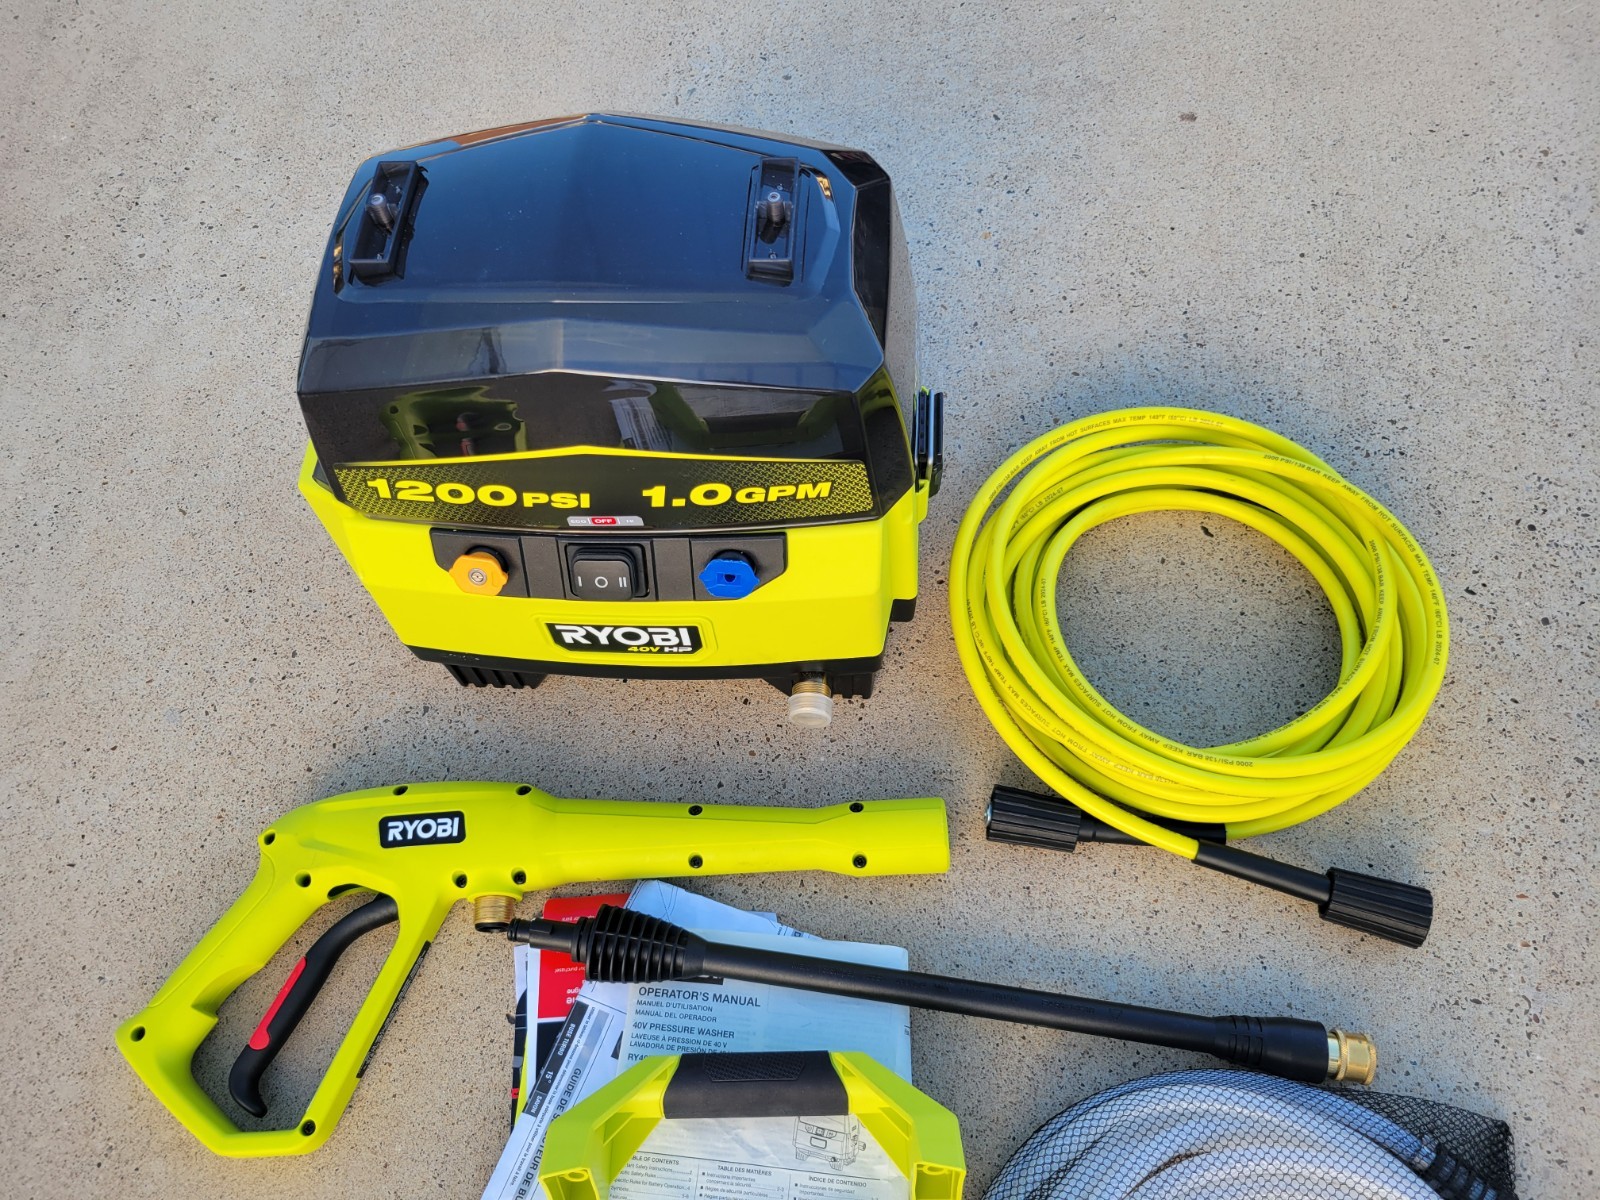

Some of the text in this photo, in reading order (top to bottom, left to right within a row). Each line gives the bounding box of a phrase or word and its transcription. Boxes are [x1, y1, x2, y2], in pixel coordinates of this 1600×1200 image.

[1020, 454, 1033, 466] KEEP
[1034, 444, 1048, 456] AWAY
[1050, 436, 1065, 446] FROM
[1066, 430, 1078, 438] HOT
[1080, 420, 1110, 432] SURFACES
[1306, 466, 1321, 474] BAR
[1323, 474, 1341, 483] KEEP
[366, 478, 590, 508] 1200 PSI
[642, 482, 832, 508] 1.0 GPM
[1044, 487, 1064, 502] 2024-07
[1342, 484, 1360, 497] AWAY
[1360, 496, 1379, 511] FROM
[1378, 510, 1392, 522] HOT
[1391, 523, 1416, 553] SURFACES
[1414, 553, 1426, 567] MAX
[1422, 570, 1434, 586] TEMP
[1041, 600, 1047, 608] LB
[1429, 589, 1440, 606] 140°F
[971, 621, 976, 629] LB
[554, 625, 692, 646] RYOBI
[1436, 630, 1442, 638] LB
[1053, 646, 1064, 662] TEMP
[1433, 641, 1442, 665] 2024-07
[994, 668, 1007, 684] TEMP
[1064, 664, 1074, 677] MAX
[1008, 685, 1020, 699] MAX
[1073, 678, 1101, 708] SURFACES
[1020, 699, 1050, 727] SURFACES
[1102, 708, 1116, 720] HOT
[1051, 727, 1066, 738] HOT
[1117, 718, 1137, 734] FROM
[1067, 737, 1088, 752] FROM
[1140, 732, 1160, 744] AWAY
[1163, 743, 1183, 754] KEEP
[1186, 752, 1203, 760] BAR
[1205, 756, 1234, 766] PSI/138
[386, 817, 460, 842] RYOBI
[638, 986, 761, 1007] OPERATOR'S MANUAL
[636, 1000, 713, 1012] MANUEL D'UTILISATION
[635, 1009, 662, 1017] MANUAL
[679, 1014, 717, 1022] OPERADOR
[566, 1023, 576, 1038] BUSE
[632, 1022, 735, 1038] 40V PRESSURE WASHER
[630, 1041, 665, 1049] LAVADORA
[631, 1033, 660, 1041] LAVEUSE
[667, 1037, 701, 1045] PRESSION
[558, 1038, 569, 1056] TURBO
[546, 1071, 554, 1084] 15°
[564, 1068, 581, 1098] GUIDE
[531, 1095, 542, 1114] SAVON
[557, 1098, 568, 1112] DE
[652, 1157, 680, 1165] CONTENTS
[746, 1168, 773, 1176] MATIÈRES
[522, 1172, 534, 1187] DE
